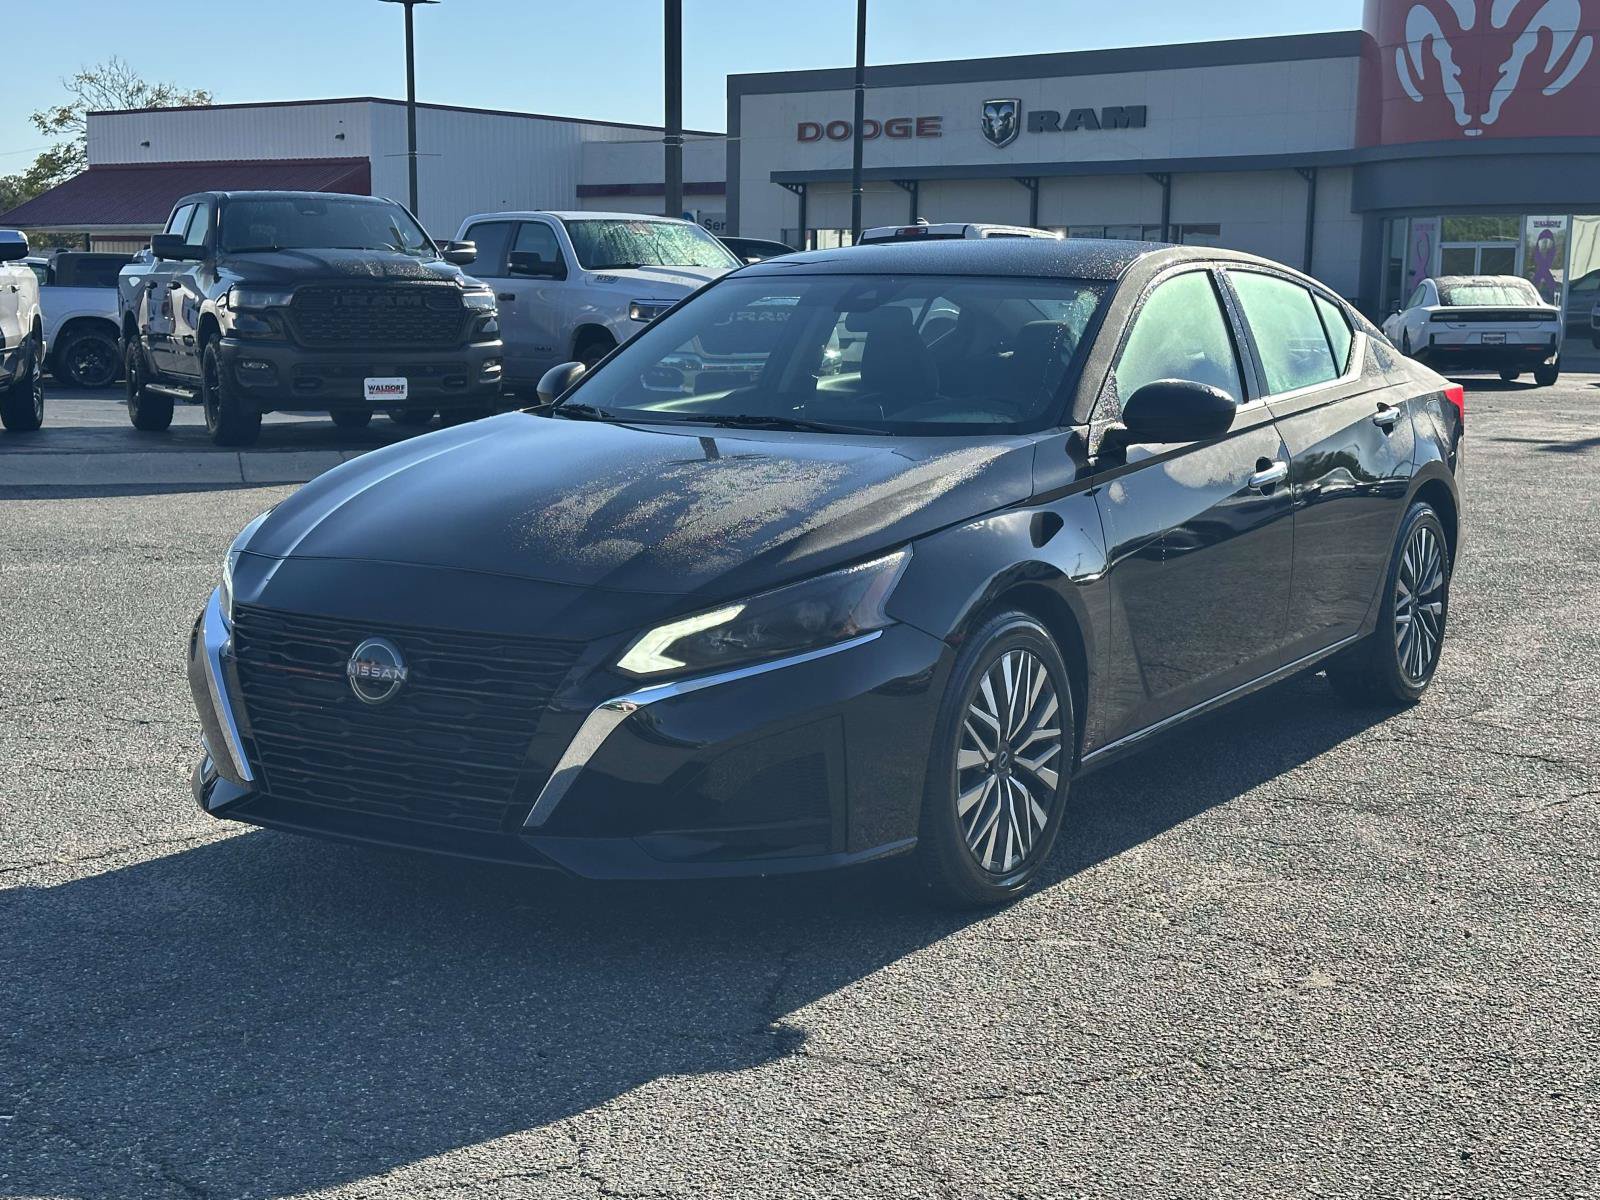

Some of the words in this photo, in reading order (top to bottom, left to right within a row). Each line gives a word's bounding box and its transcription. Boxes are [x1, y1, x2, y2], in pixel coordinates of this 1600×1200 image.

[797, 116, 943, 142] DODGE
[1027, 105, 1147, 133] RAM
[347, 661, 408, 681] NISSAN
